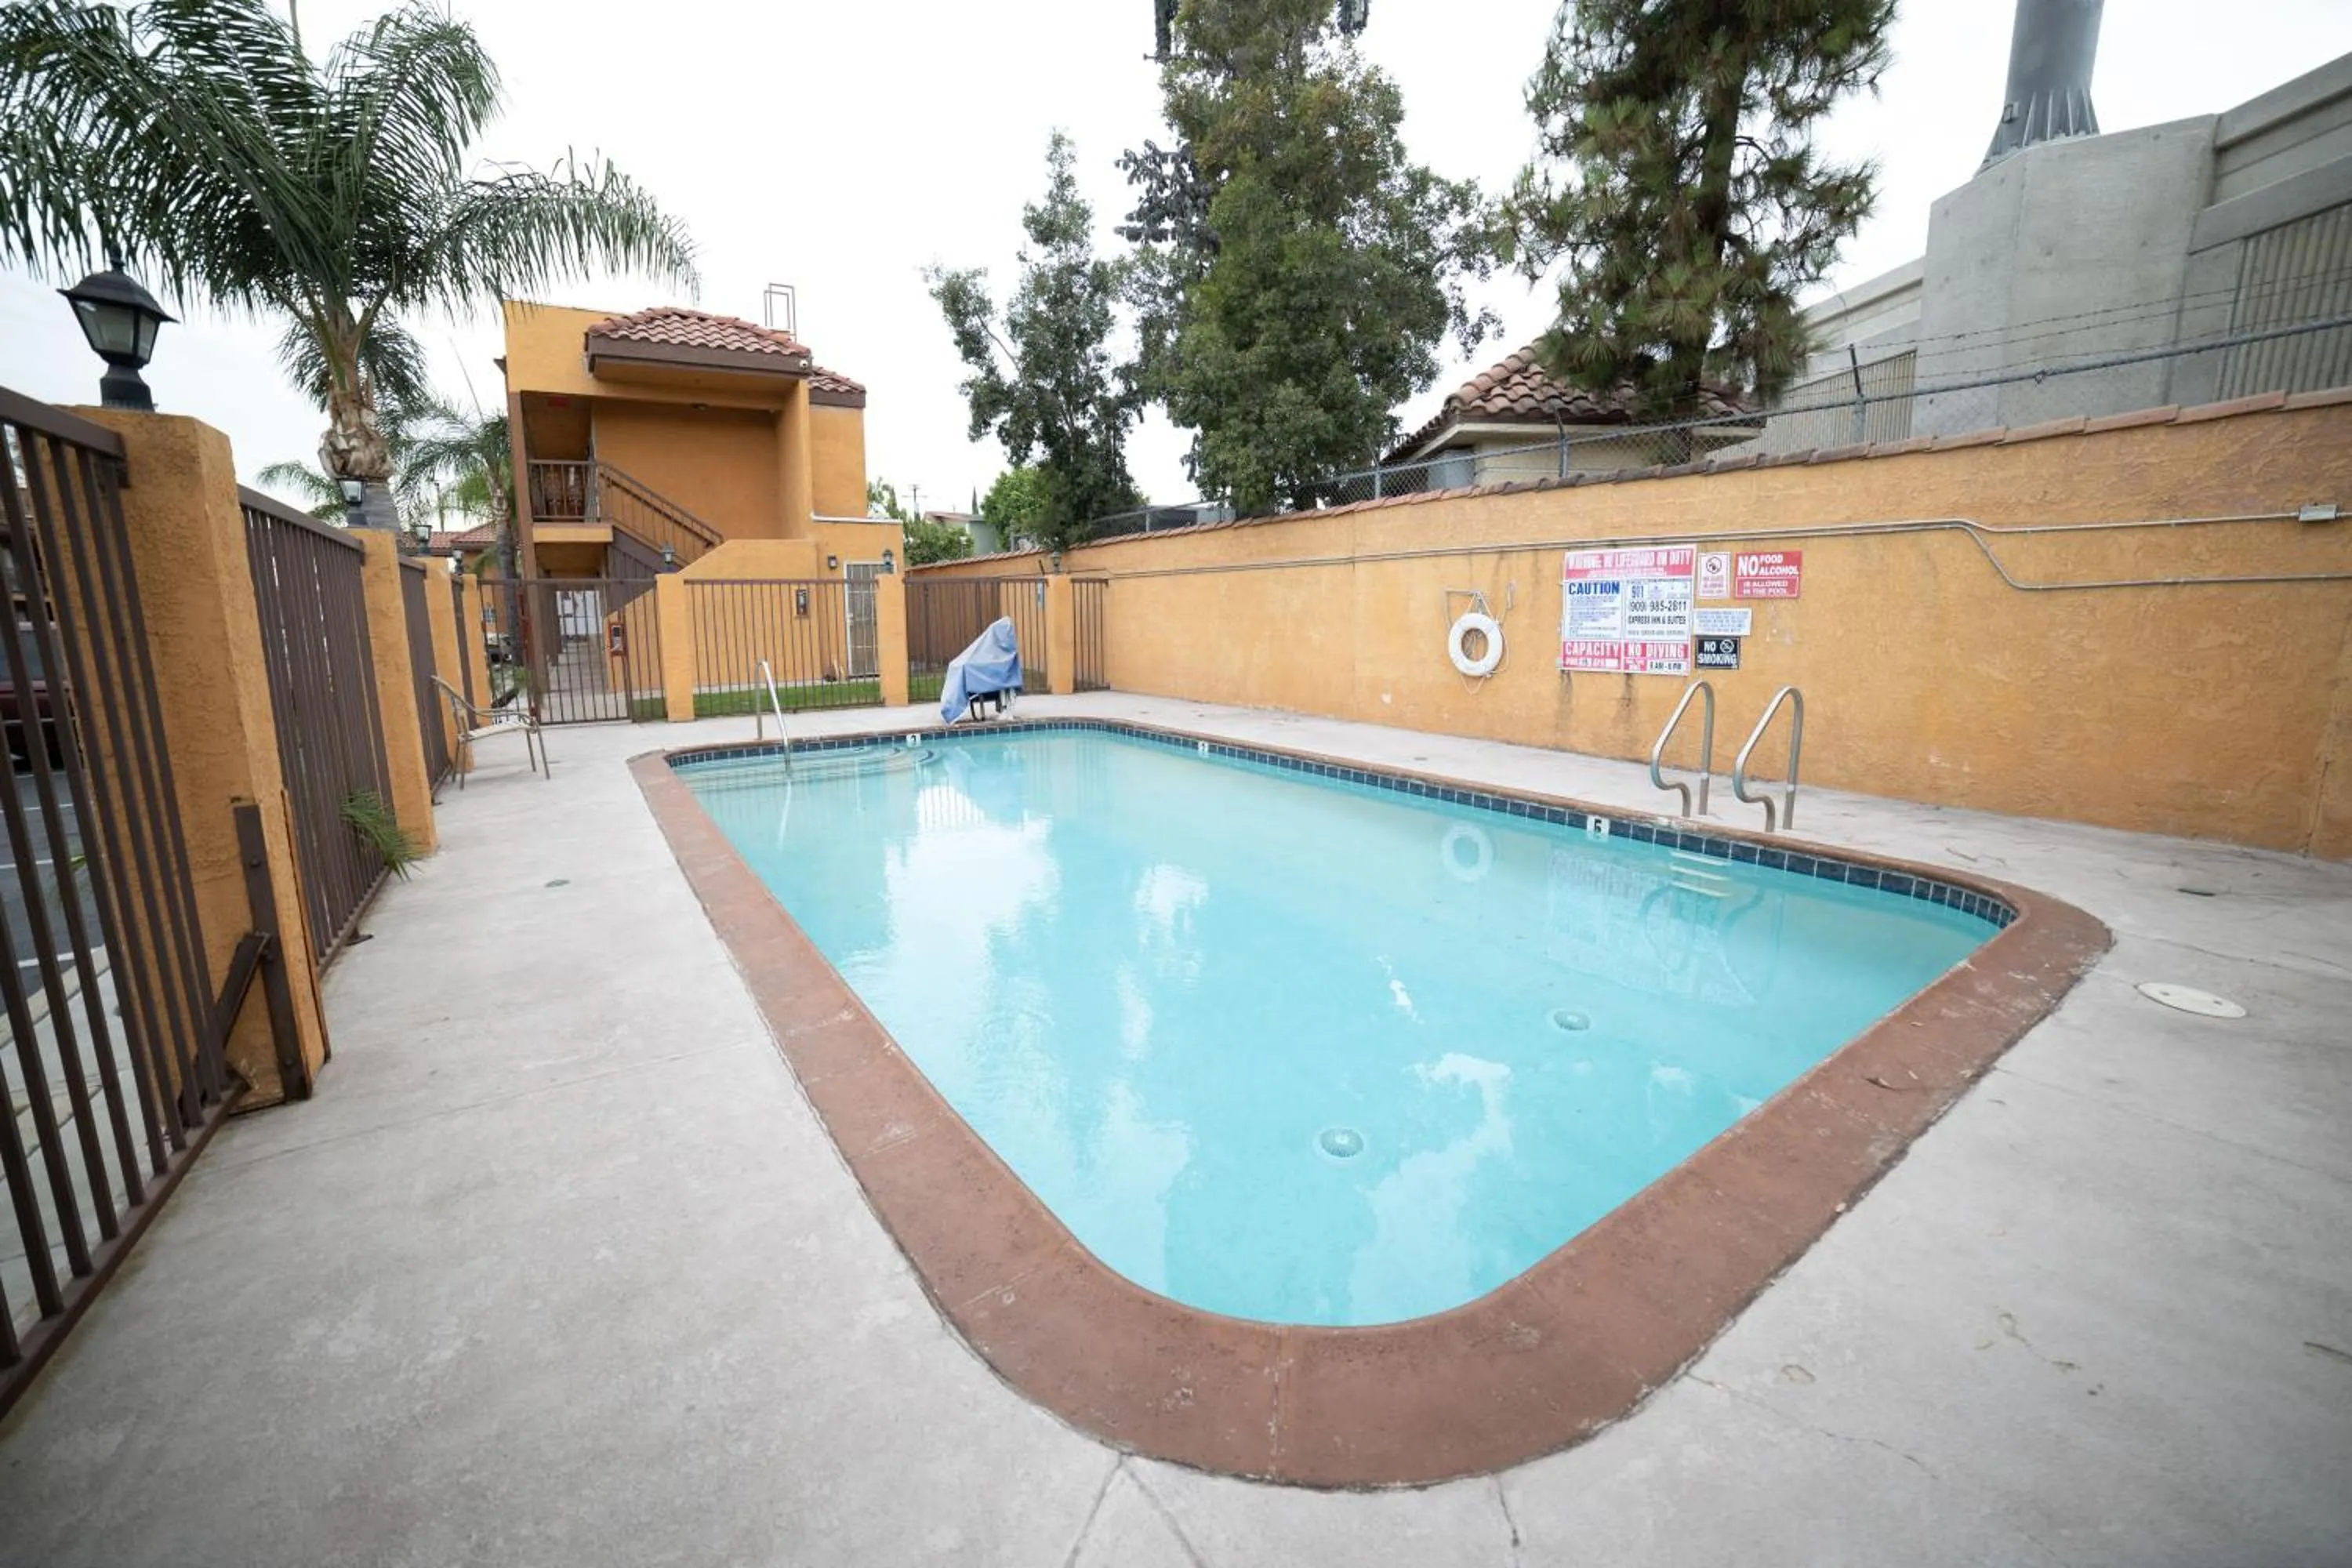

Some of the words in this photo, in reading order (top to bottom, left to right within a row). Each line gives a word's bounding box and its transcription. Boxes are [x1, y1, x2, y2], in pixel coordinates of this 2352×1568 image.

[1669, 550, 1691, 565] DUTY
[1759, 554, 1784, 564] FOOD
[1737, 554, 1759, 576] NO
[1759, 564, 1798, 576] ALCOHOL
[1569, 582, 1620, 595] CAUTION
[1566, 641, 1619, 656] CAPACITY
[1628, 642, 1642, 657] NO
[1646, 643, 1684, 659] DIVING
[1704, 641, 1716, 652] NO
[1698, 652, 1737, 666] SMOKING
